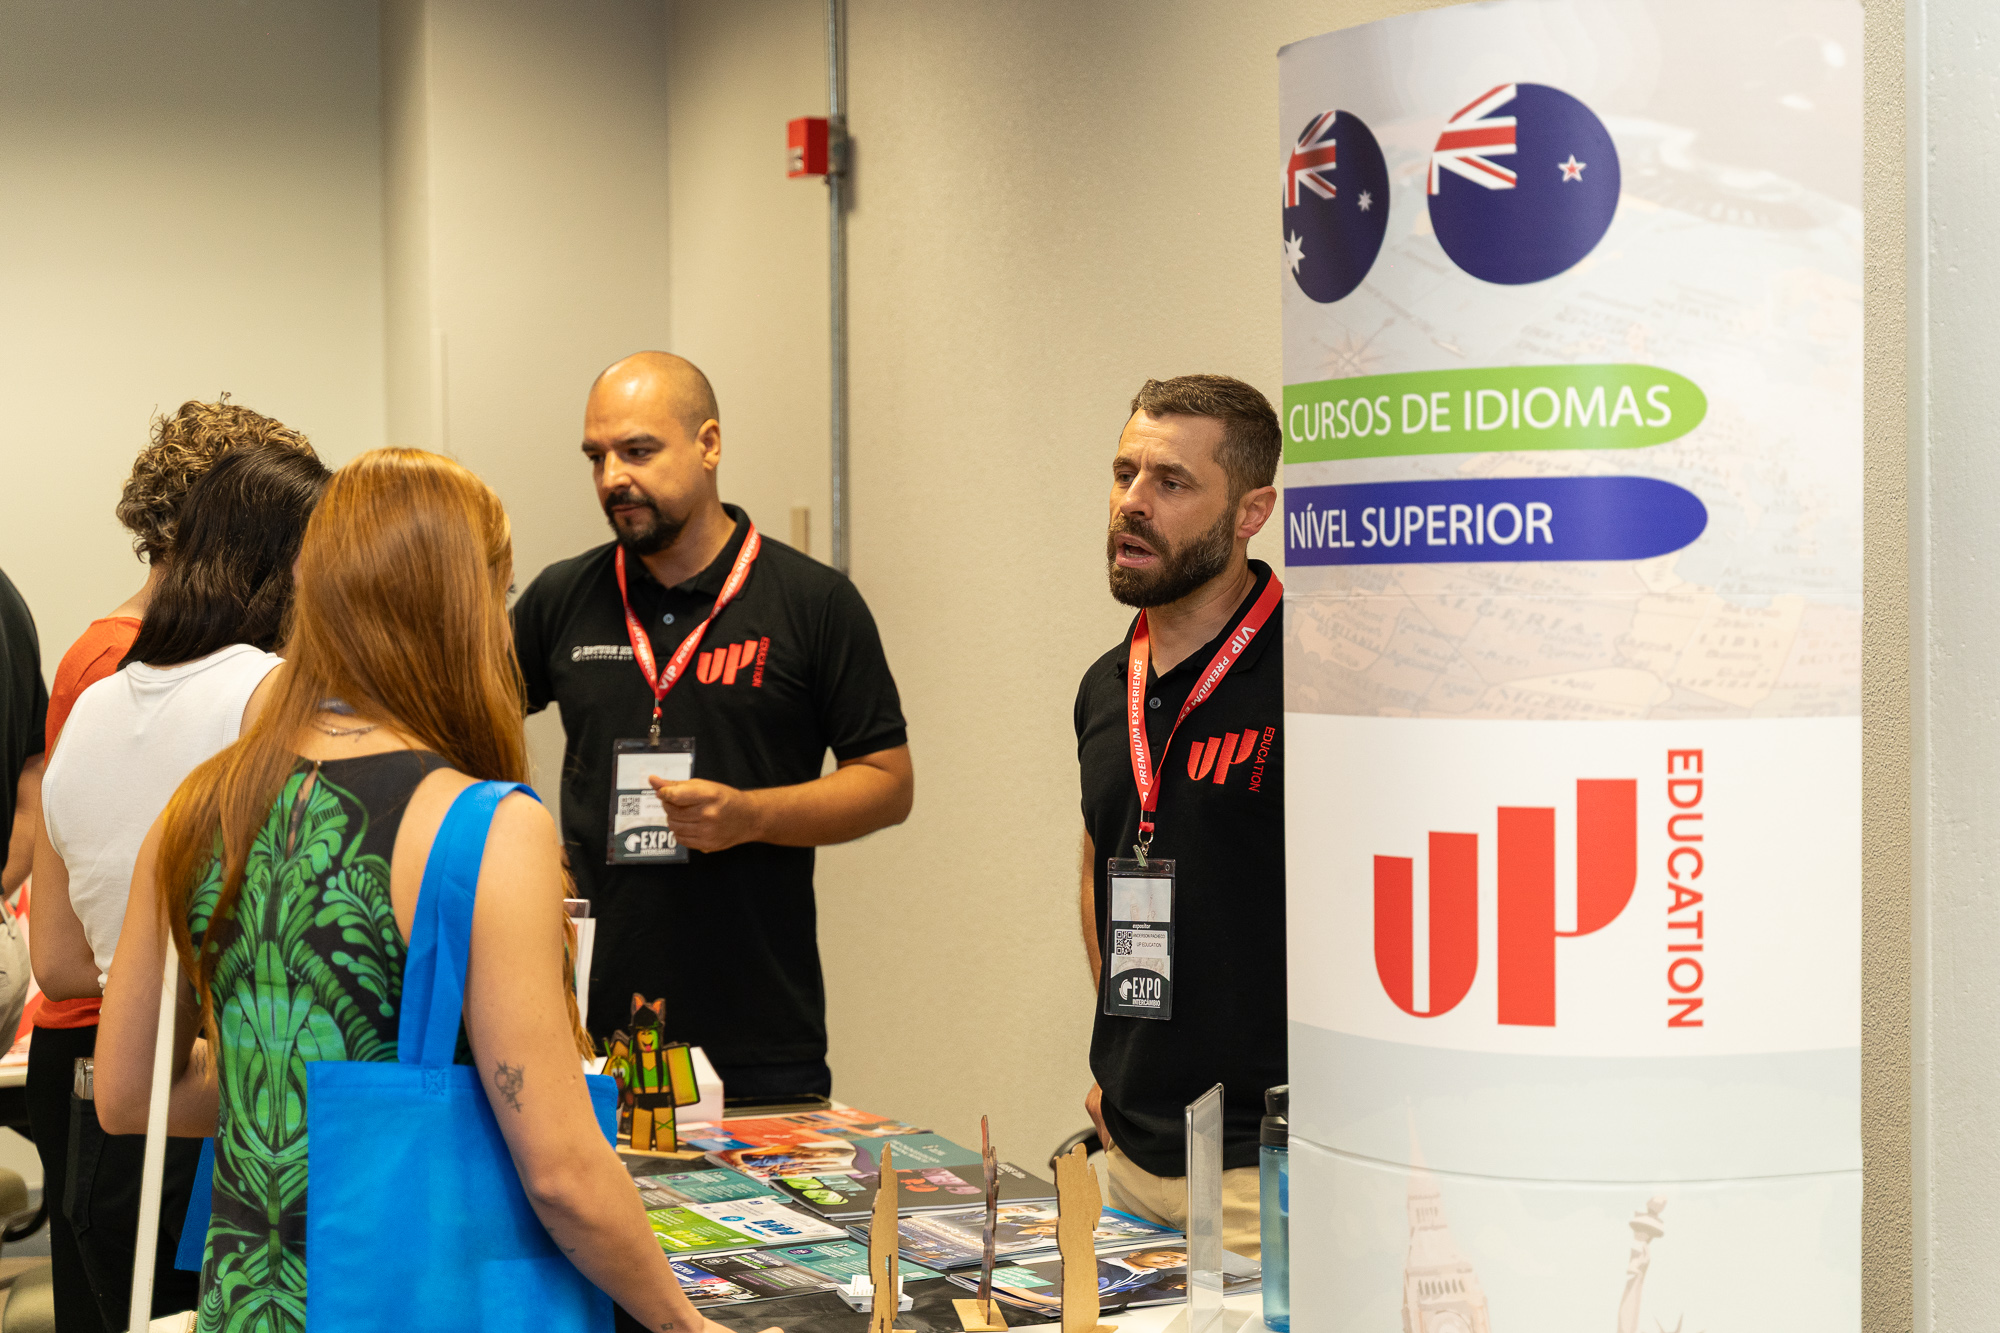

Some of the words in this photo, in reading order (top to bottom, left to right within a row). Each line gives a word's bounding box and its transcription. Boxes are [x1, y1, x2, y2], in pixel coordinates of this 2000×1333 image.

[1289, 395, 1392, 443] CURSOS
[1402, 391, 1451, 434] DE
[1463, 384, 1672, 431] IDIOMAS
[1289, 503, 1355, 549] NÍVEL
[1361, 501, 1554, 548] SUPERIOR
[696, 640, 758, 685] UP
[751, 636, 771, 688] EDUCATION
[1231, 626, 1256, 655] VIP
[658, 665, 677, 690] VIP
[1131, 658, 1143, 725] EXPERIENCE
[1191, 655, 1230, 708] PREMIUM
[1132, 727, 1149, 785] PREMIUM
[1187, 728, 1259, 785] UP
[1248, 725, 1276, 793] EDUCATION
[641, 831, 675, 849] EXPO
[1373, 778, 1638, 1028] UP
[1666, 748, 1705, 1028] EDUCATION
[1132, 977, 1161, 1000] EXPO
